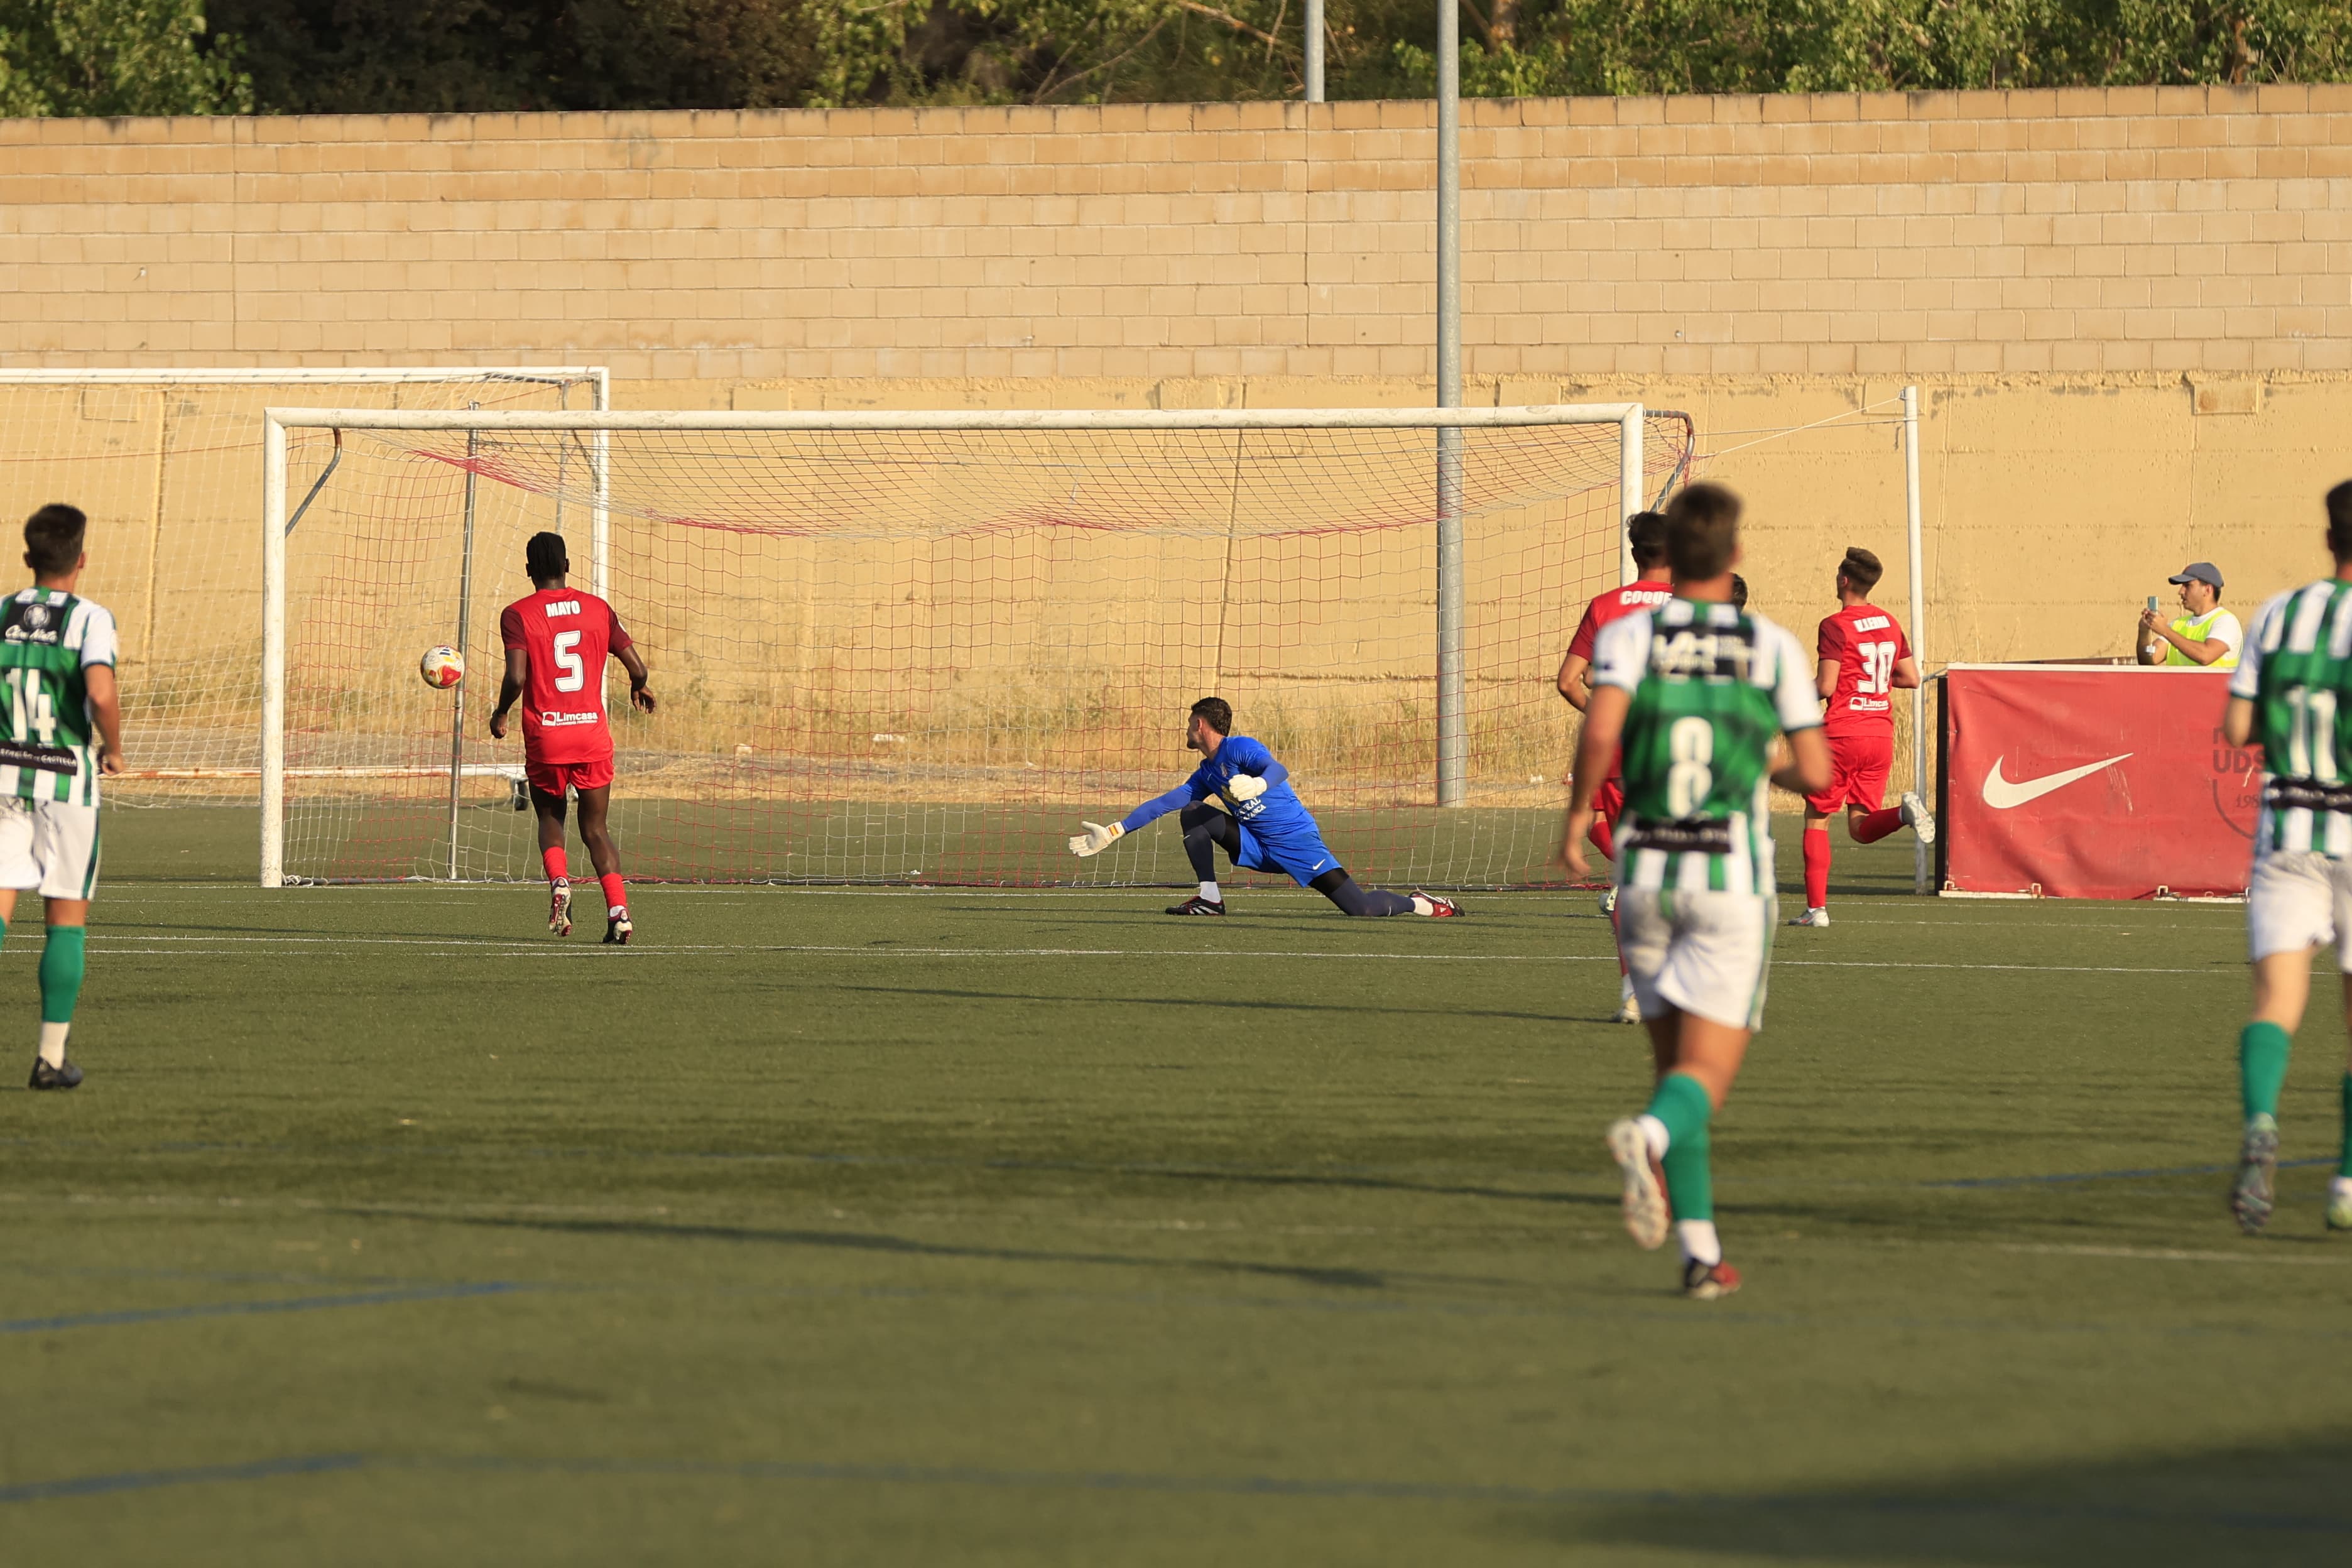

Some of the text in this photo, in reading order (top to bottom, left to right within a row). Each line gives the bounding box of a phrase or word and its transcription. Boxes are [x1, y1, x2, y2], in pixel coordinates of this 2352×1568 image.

[545, 600, 581, 618] MAYO
[553, 630, 584, 693] 5
[1858, 641, 1897, 694] 30
[6, 668, 57, 748] 14
[557, 712, 598, 722] Limcasa
[2285, 685, 2344, 788] 11
[1667, 716, 1713, 822] 8
